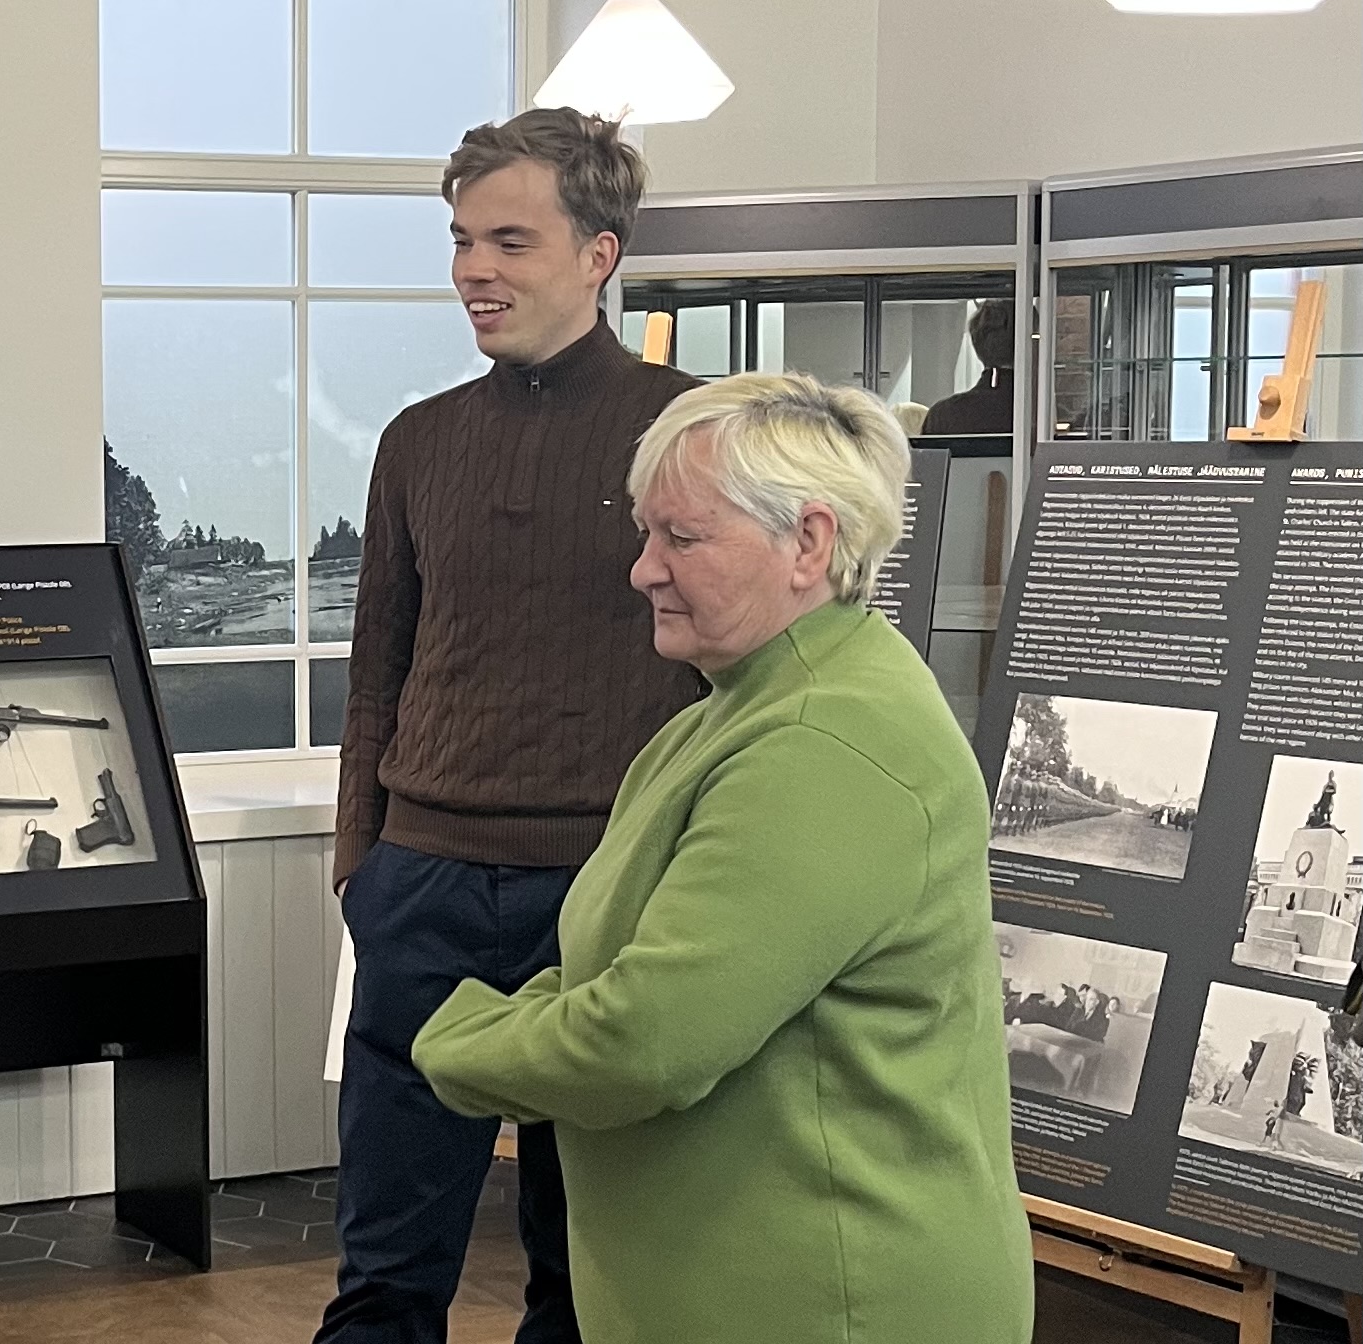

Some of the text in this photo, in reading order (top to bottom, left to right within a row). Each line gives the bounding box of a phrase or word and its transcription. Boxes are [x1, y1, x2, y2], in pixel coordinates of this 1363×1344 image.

[1090, 465, 1143, 477] KARISTUSED,
[1147, 464, 1194, 476] MÄLESTUSE
[1196, 464, 1266, 478] JÄÄDVUSTAMINE
[1290, 467, 1329, 481] AWARDS,
